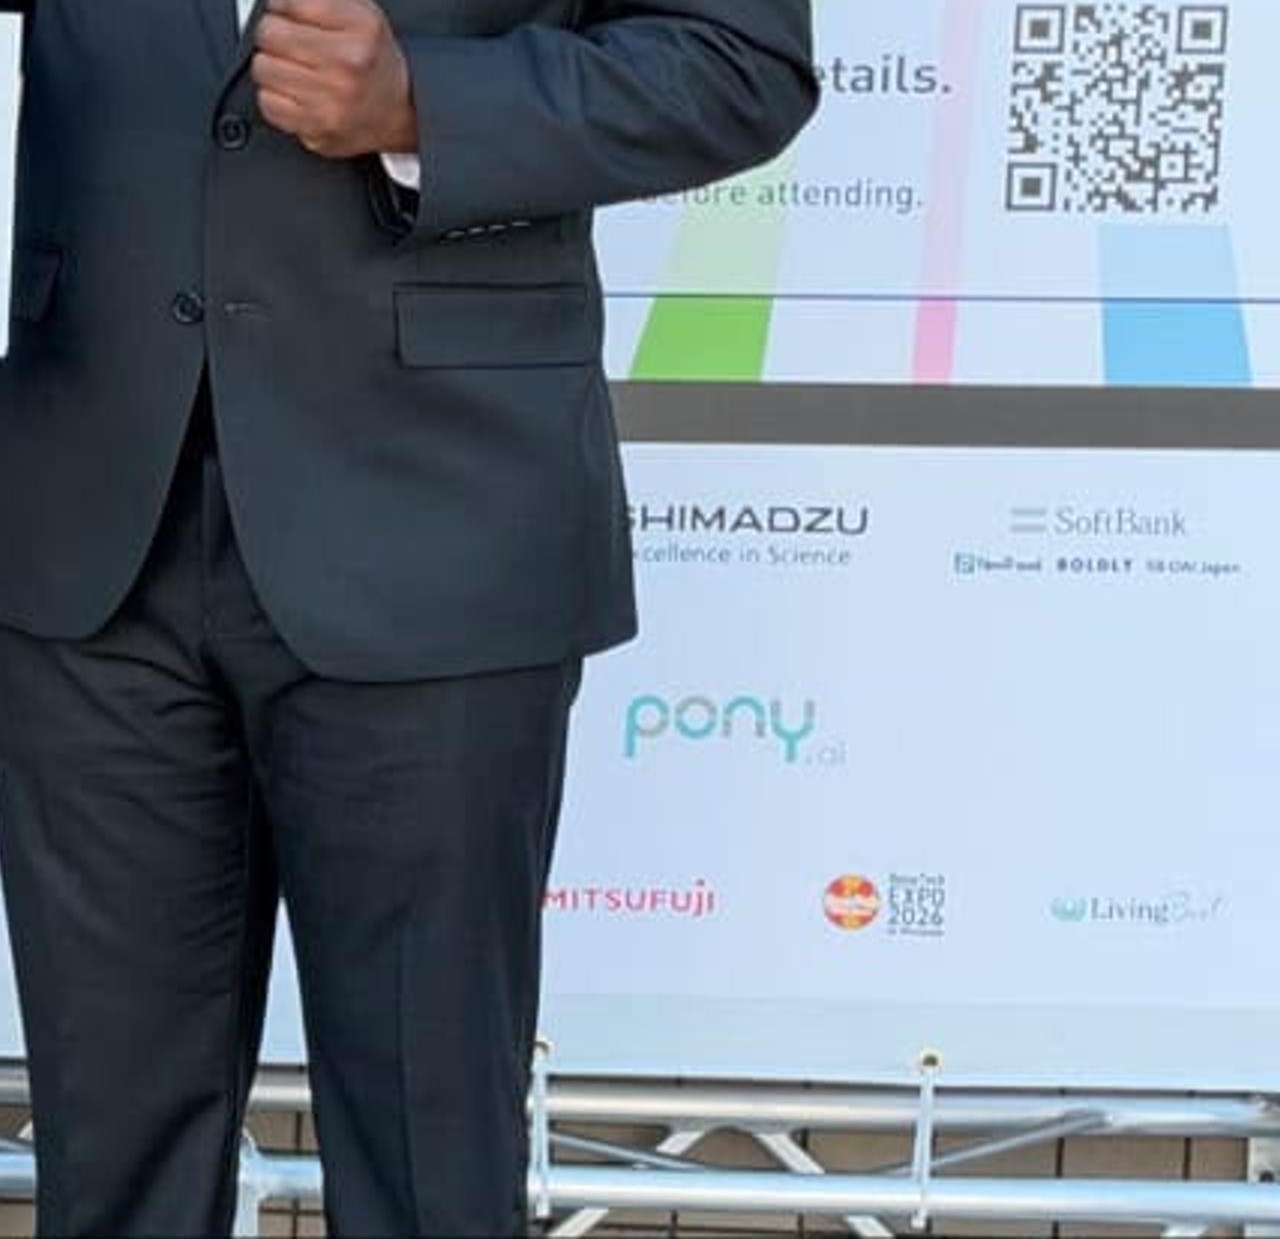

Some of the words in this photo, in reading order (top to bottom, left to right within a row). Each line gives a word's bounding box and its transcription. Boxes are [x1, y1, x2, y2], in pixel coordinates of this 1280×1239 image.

[758, 179, 923, 213] attending.
[1055, 508, 1186, 535] SoftBank
[632, 544, 732, 563] cellence
[768, 547, 851, 565] Science
[888, 905, 943, 925] 2026
